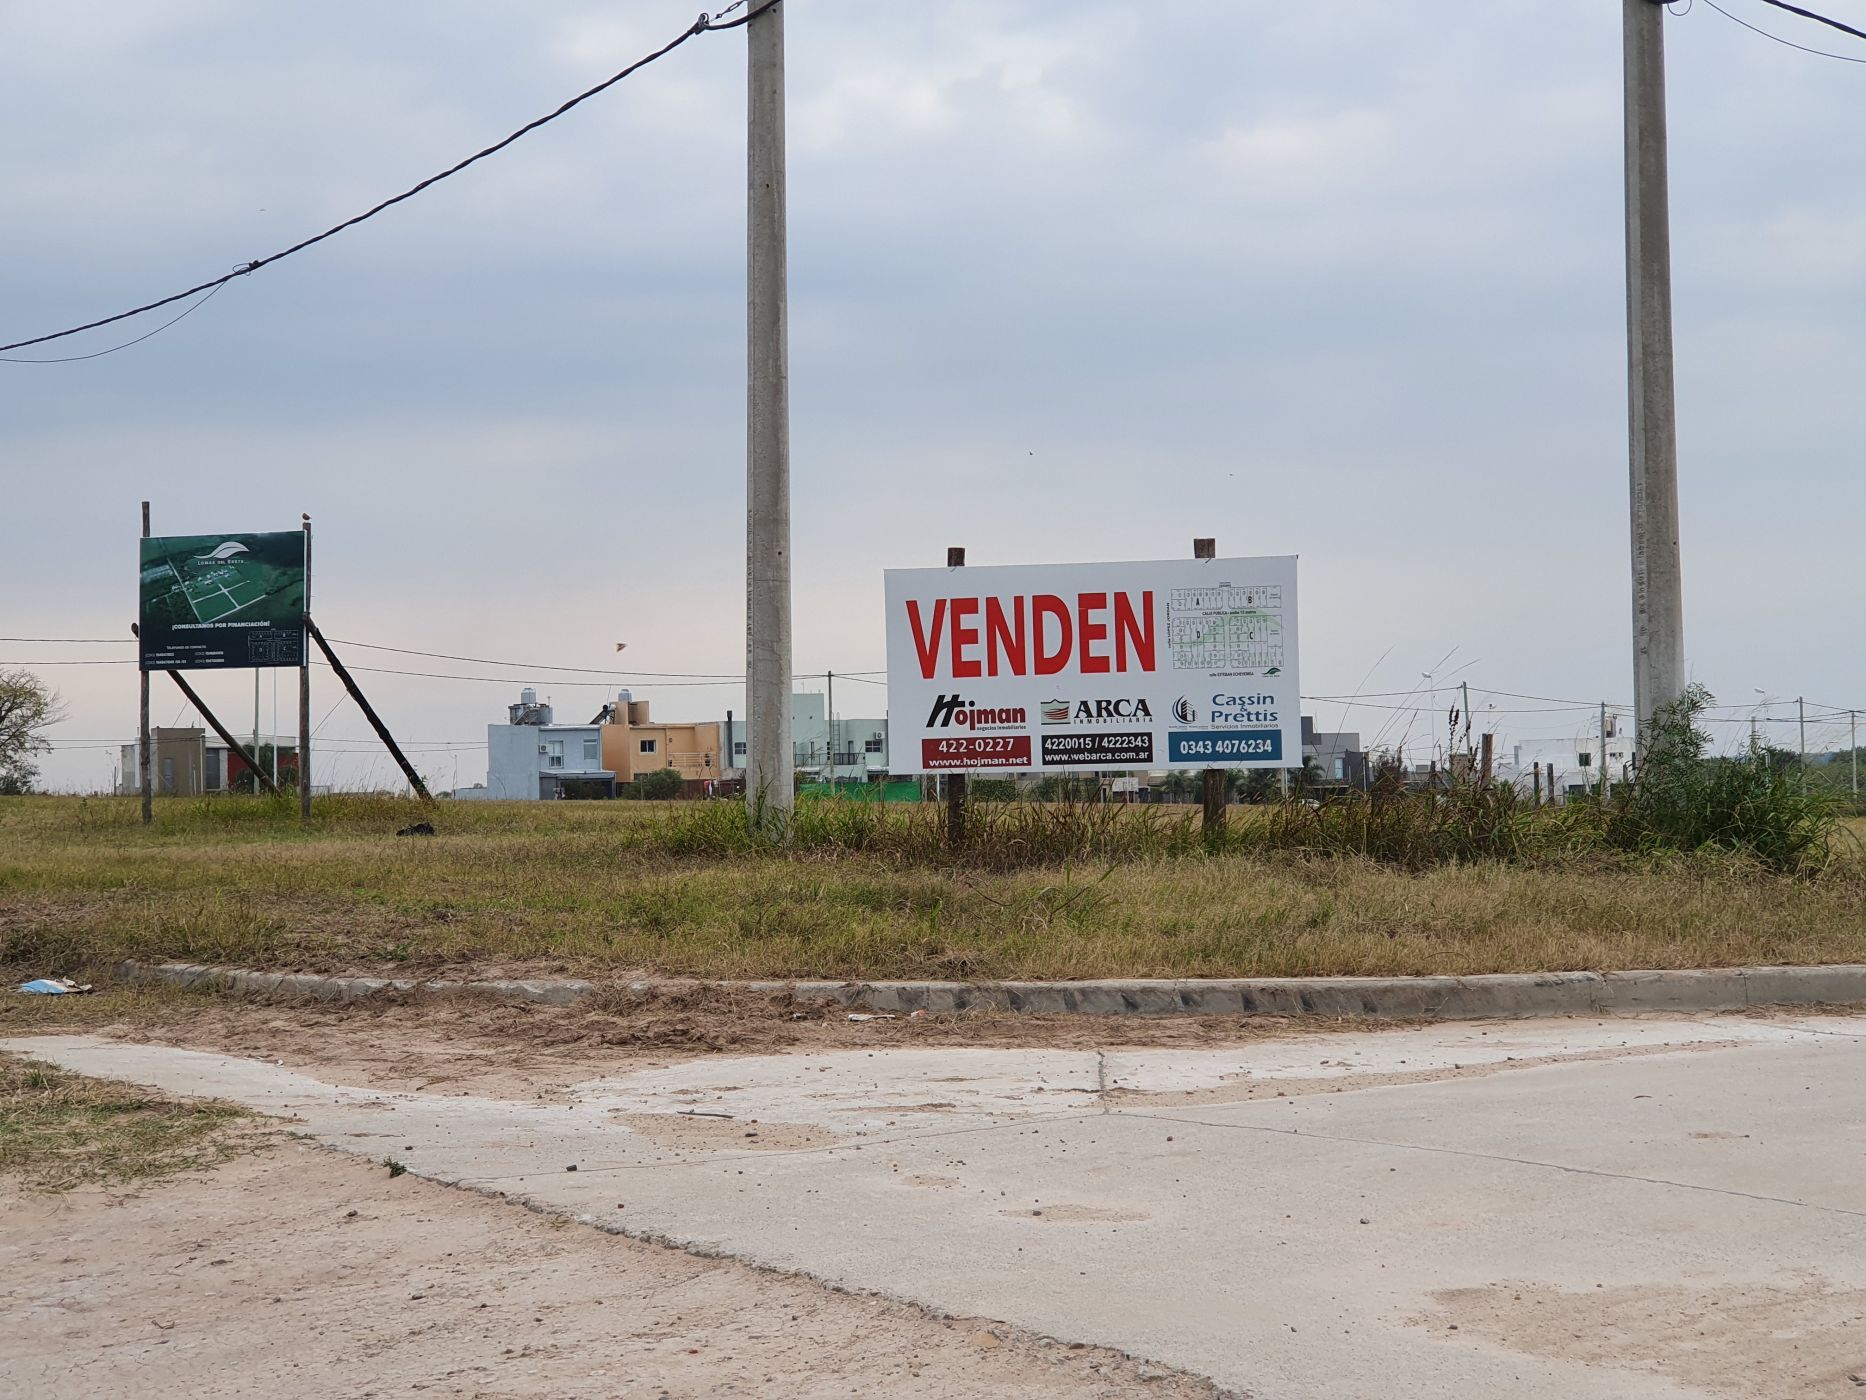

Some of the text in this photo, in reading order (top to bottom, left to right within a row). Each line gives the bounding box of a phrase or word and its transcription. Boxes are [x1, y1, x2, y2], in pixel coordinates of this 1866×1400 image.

[1196, 598, 1200, 606] A
[906, 591, 1156, 679] VENDEN
[1212, 693, 1274, 706] Cassin
[926, 694, 1026, 730] Hojman
[1074, 699, 1152, 718] ARCA
[1211, 710, 1278, 722] Prettis
[938, 738, 1014, 752] 422-0227
[1045, 736, 1149, 750] 4220015 / 4222343
[1180, 740, 1272, 754] 0343 4076234
[929, 756, 1028, 766] www.hojman.net
[1045, 752, 1149, 761] www.webarca.com.ar
